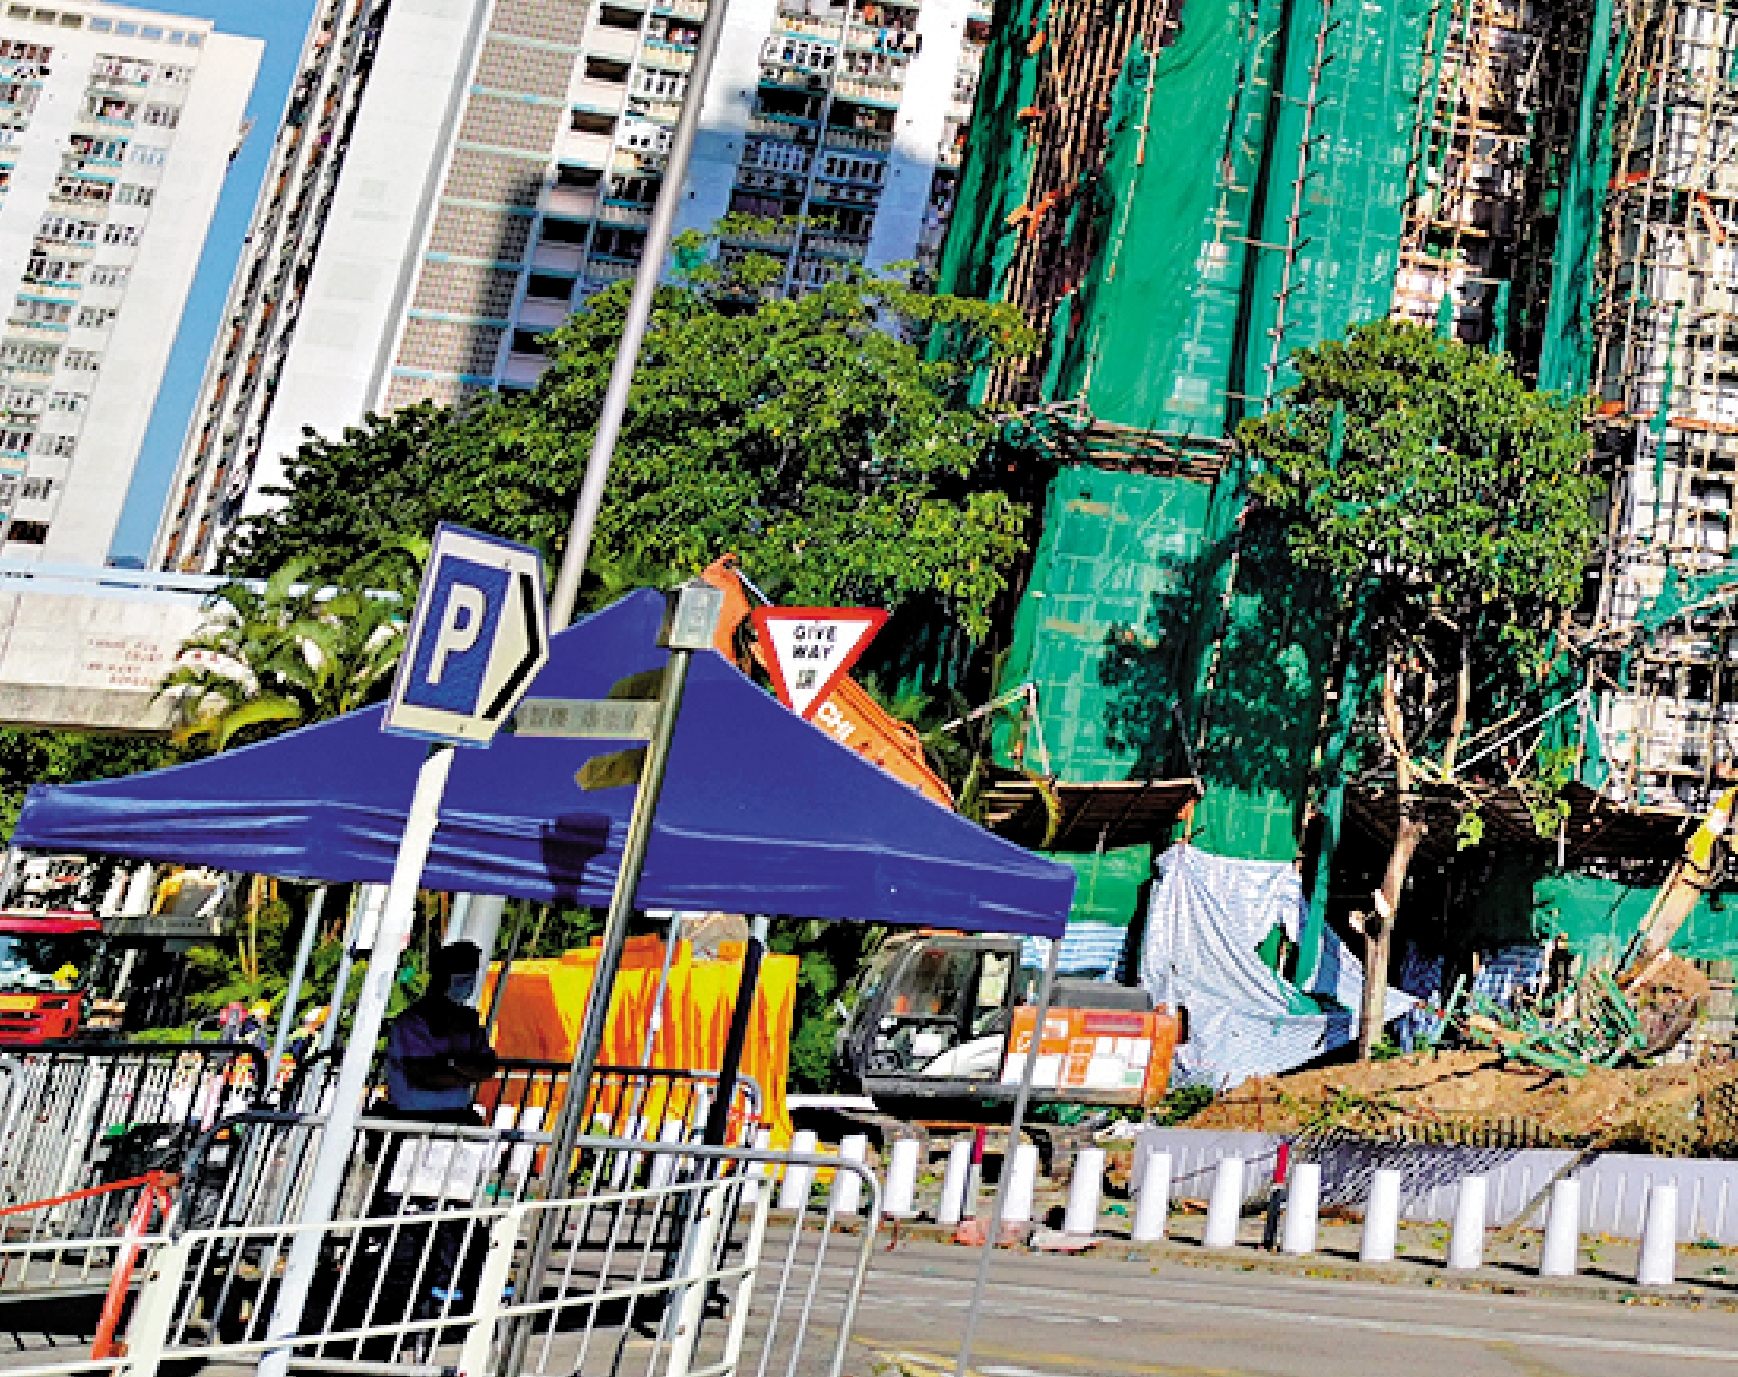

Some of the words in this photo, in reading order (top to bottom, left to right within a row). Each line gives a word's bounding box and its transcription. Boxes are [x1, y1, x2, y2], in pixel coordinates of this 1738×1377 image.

[426, 583, 487, 684] P
[793, 623, 837, 642] GIVE
[793, 644, 834, 661] WAY
